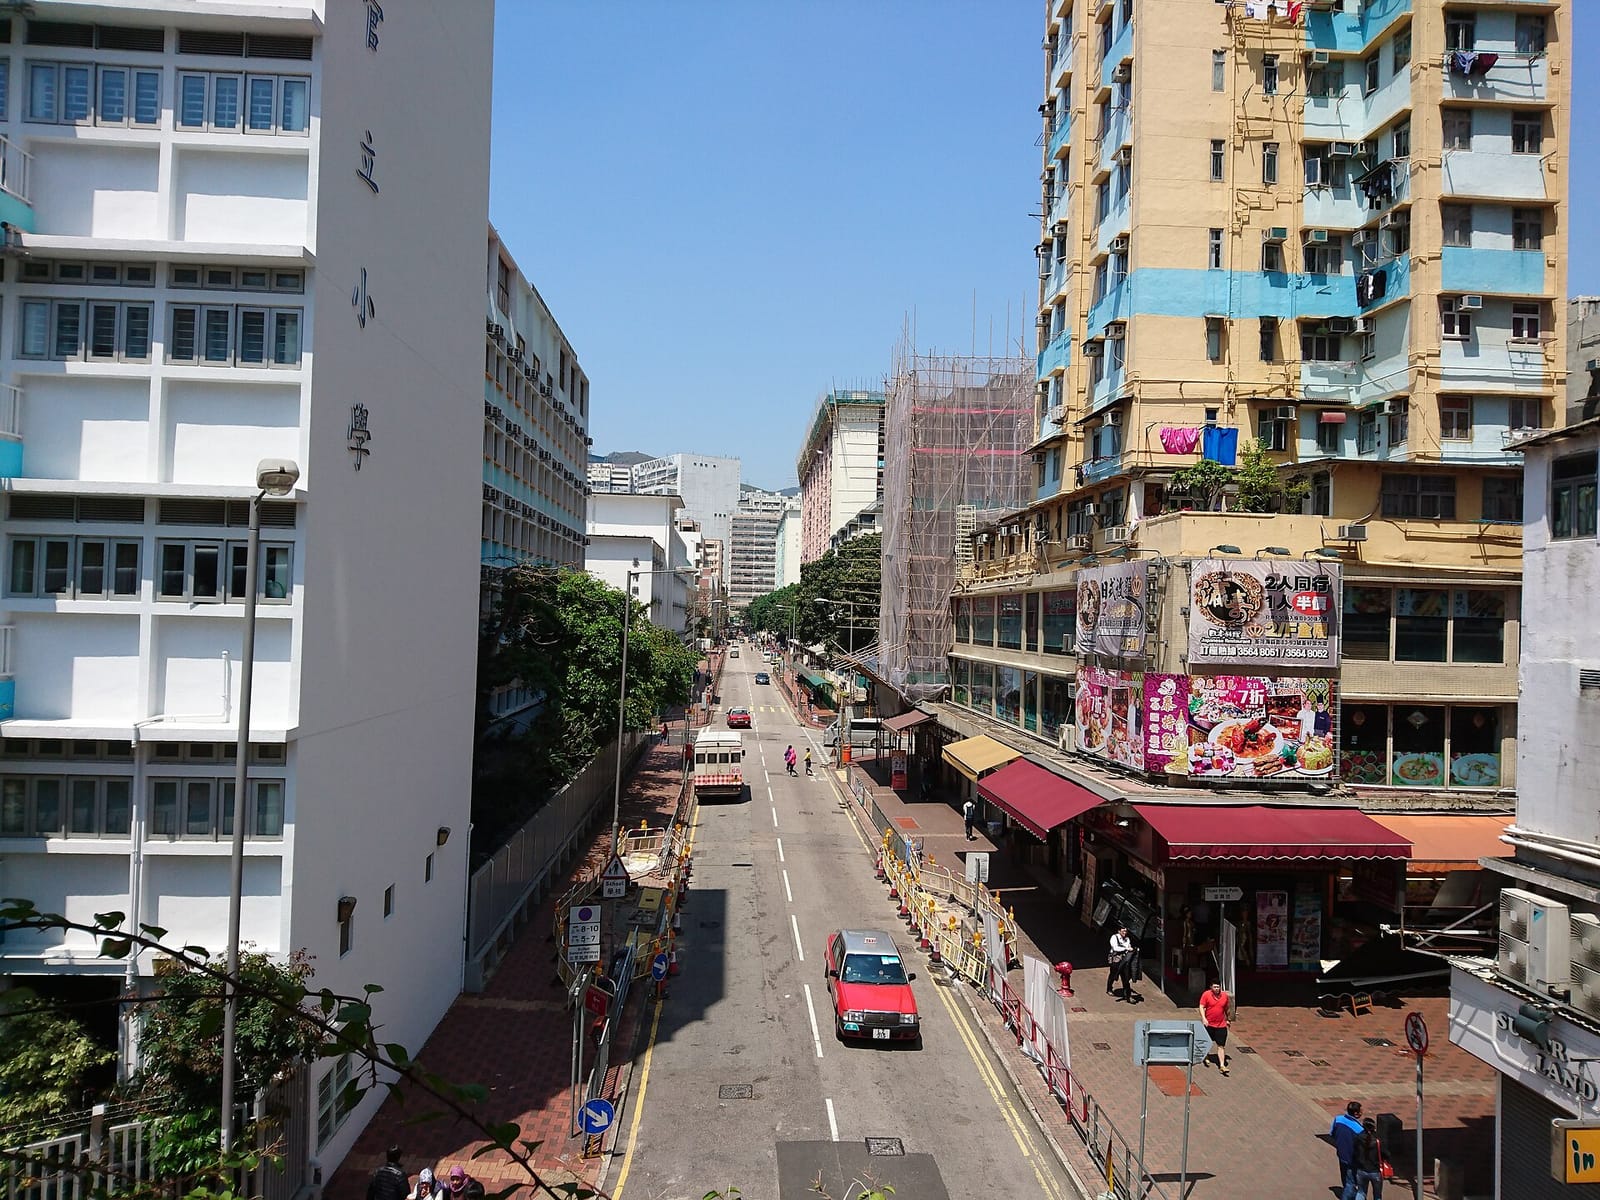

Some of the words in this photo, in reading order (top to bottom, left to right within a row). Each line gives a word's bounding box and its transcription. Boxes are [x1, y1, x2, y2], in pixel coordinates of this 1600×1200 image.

[1265, 576, 1330, 592] 2人同行
[1265, 595, 1328, 611] 1人半價
[1237, 647, 1259, 656] 3564
[1260, 648, 1281, 657] 8051
[1285, 649, 1307, 658] 3564
[1307, 650, 1329, 659] 8052
[1238, 689, 1264, 705] 7折
[1496, 1014, 1568, 1062] SUR
[1535, 1053, 1598, 1102] LAND
